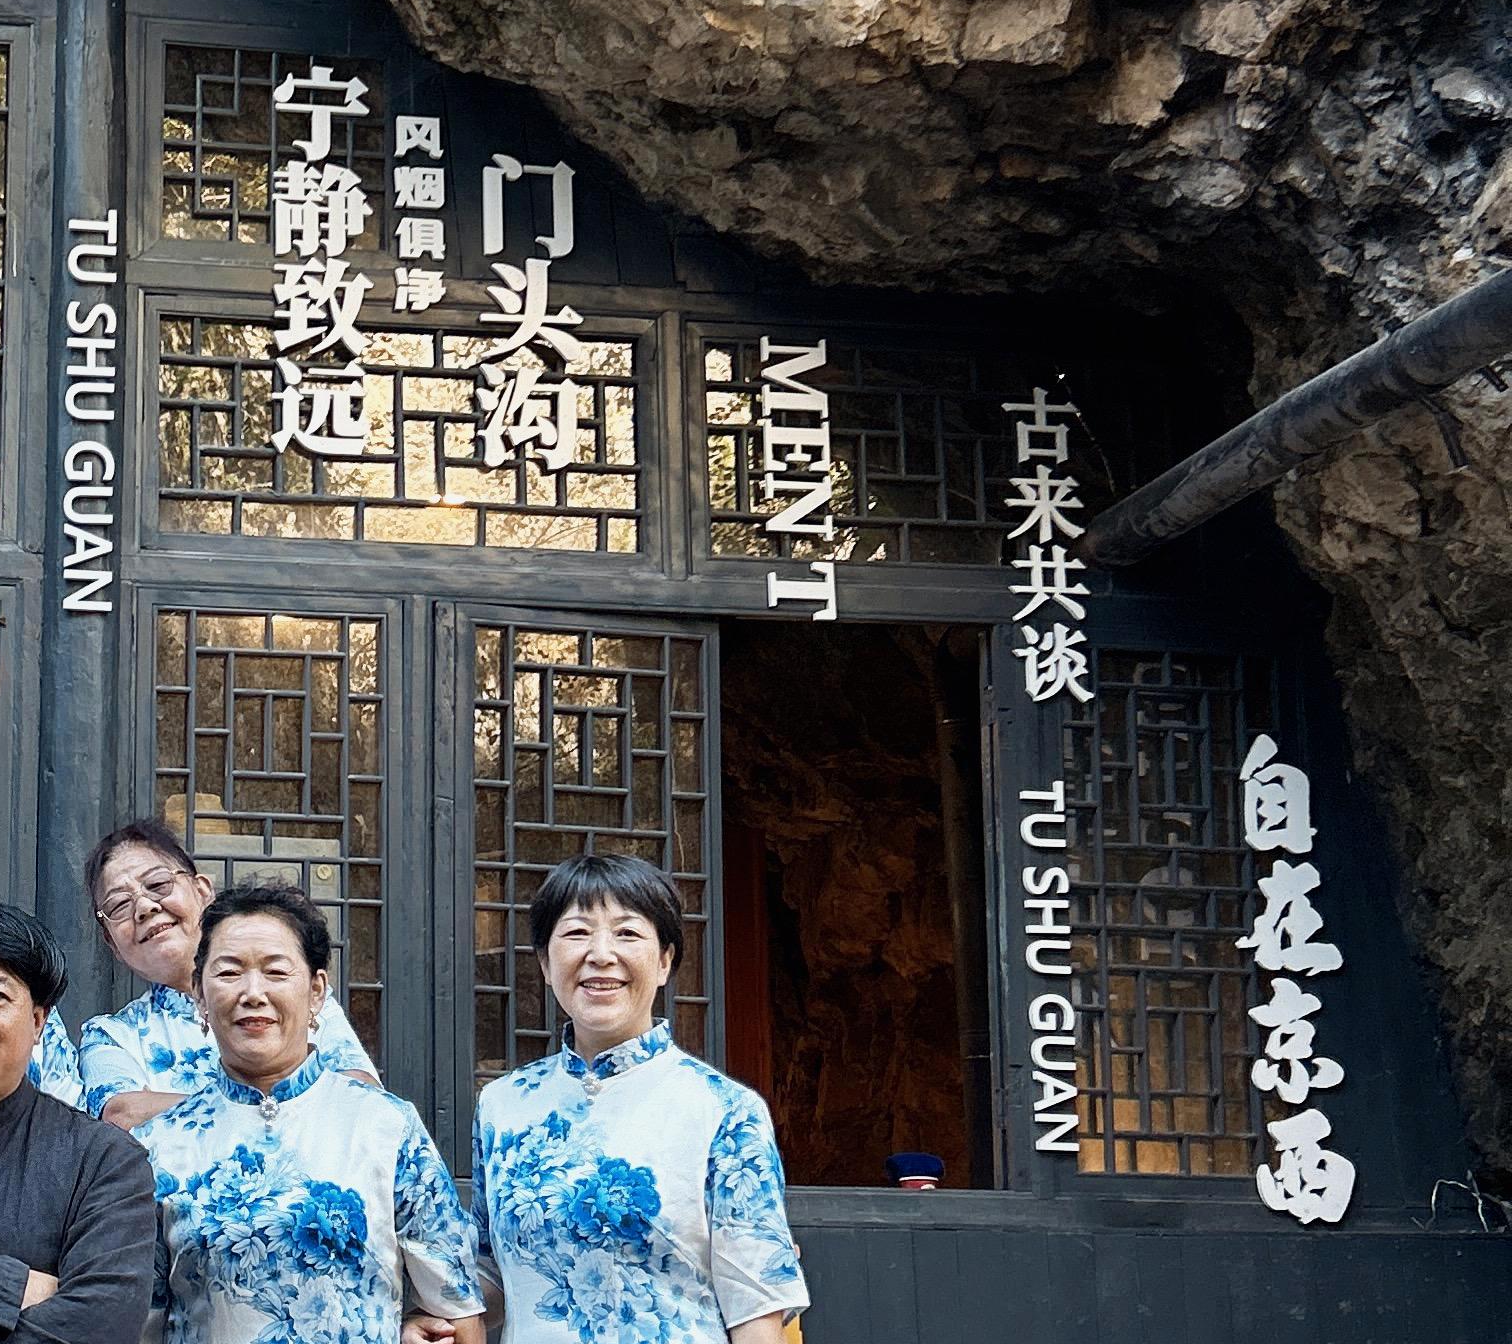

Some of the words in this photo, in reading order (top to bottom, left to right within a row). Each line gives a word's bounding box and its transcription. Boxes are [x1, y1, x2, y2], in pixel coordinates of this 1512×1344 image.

[66, 210, 118, 284] TU
[271, 66, 375, 457] 宁静致远
[393, 115, 447, 313] 风烟俱净
[65, 300, 117, 422] SHU
[476, 154, 586, 472] 门头沟
[62, 439, 116, 613] GUAN
[1001, 386, 1094, 704] 古来共谈
[1018, 780, 1068, 851] TU
[1021, 865, 1072, 976] SHU
[1235, 732, 1356, 1225] 自在京西
[1028, 993, 1080, 1153] GUAN
